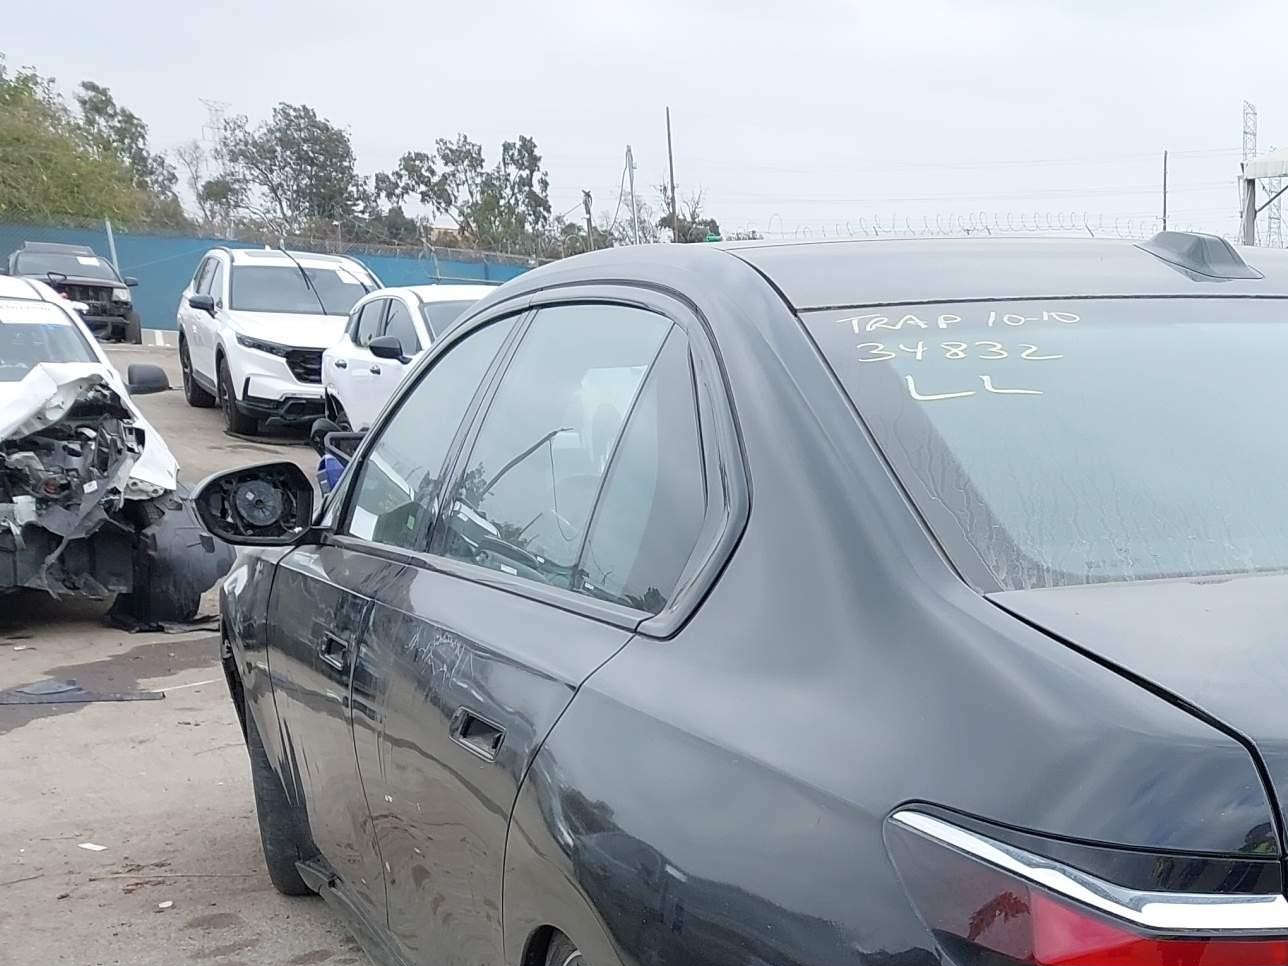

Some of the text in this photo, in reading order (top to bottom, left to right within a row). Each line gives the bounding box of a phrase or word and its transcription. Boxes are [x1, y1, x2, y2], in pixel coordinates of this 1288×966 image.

[836, 311, 1081, 333] TRAP 10-10
[856, 341, 1065, 362] 34832
